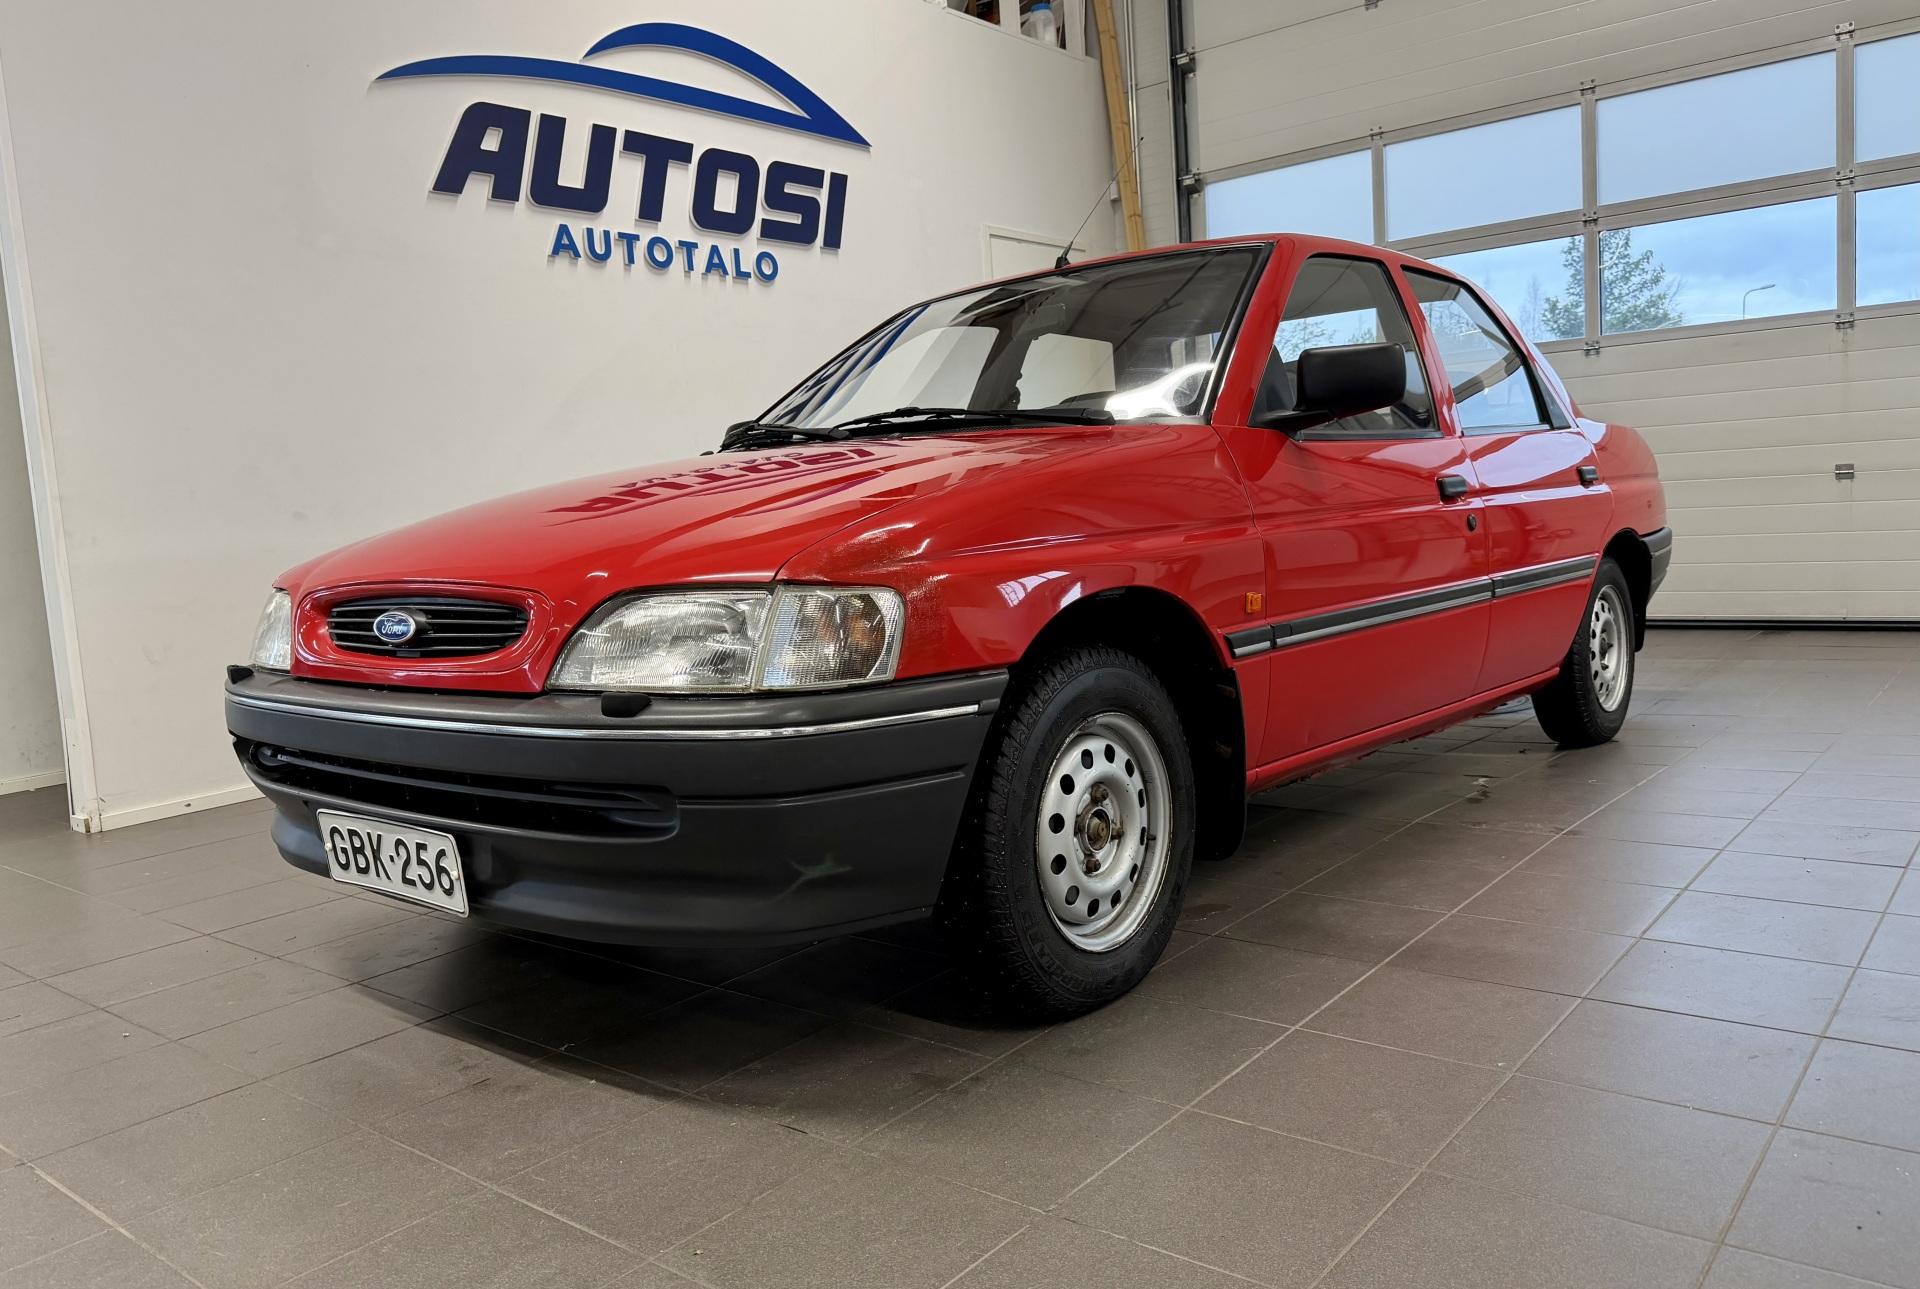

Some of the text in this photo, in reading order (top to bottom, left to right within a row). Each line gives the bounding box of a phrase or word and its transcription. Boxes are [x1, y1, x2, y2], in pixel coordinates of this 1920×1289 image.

[432, 102, 849, 250] AUTOSI
[550, 223, 779, 283] AUTOTALO
[380, 616, 411, 634] Ford
[329, 826, 455, 896] GBK-256
